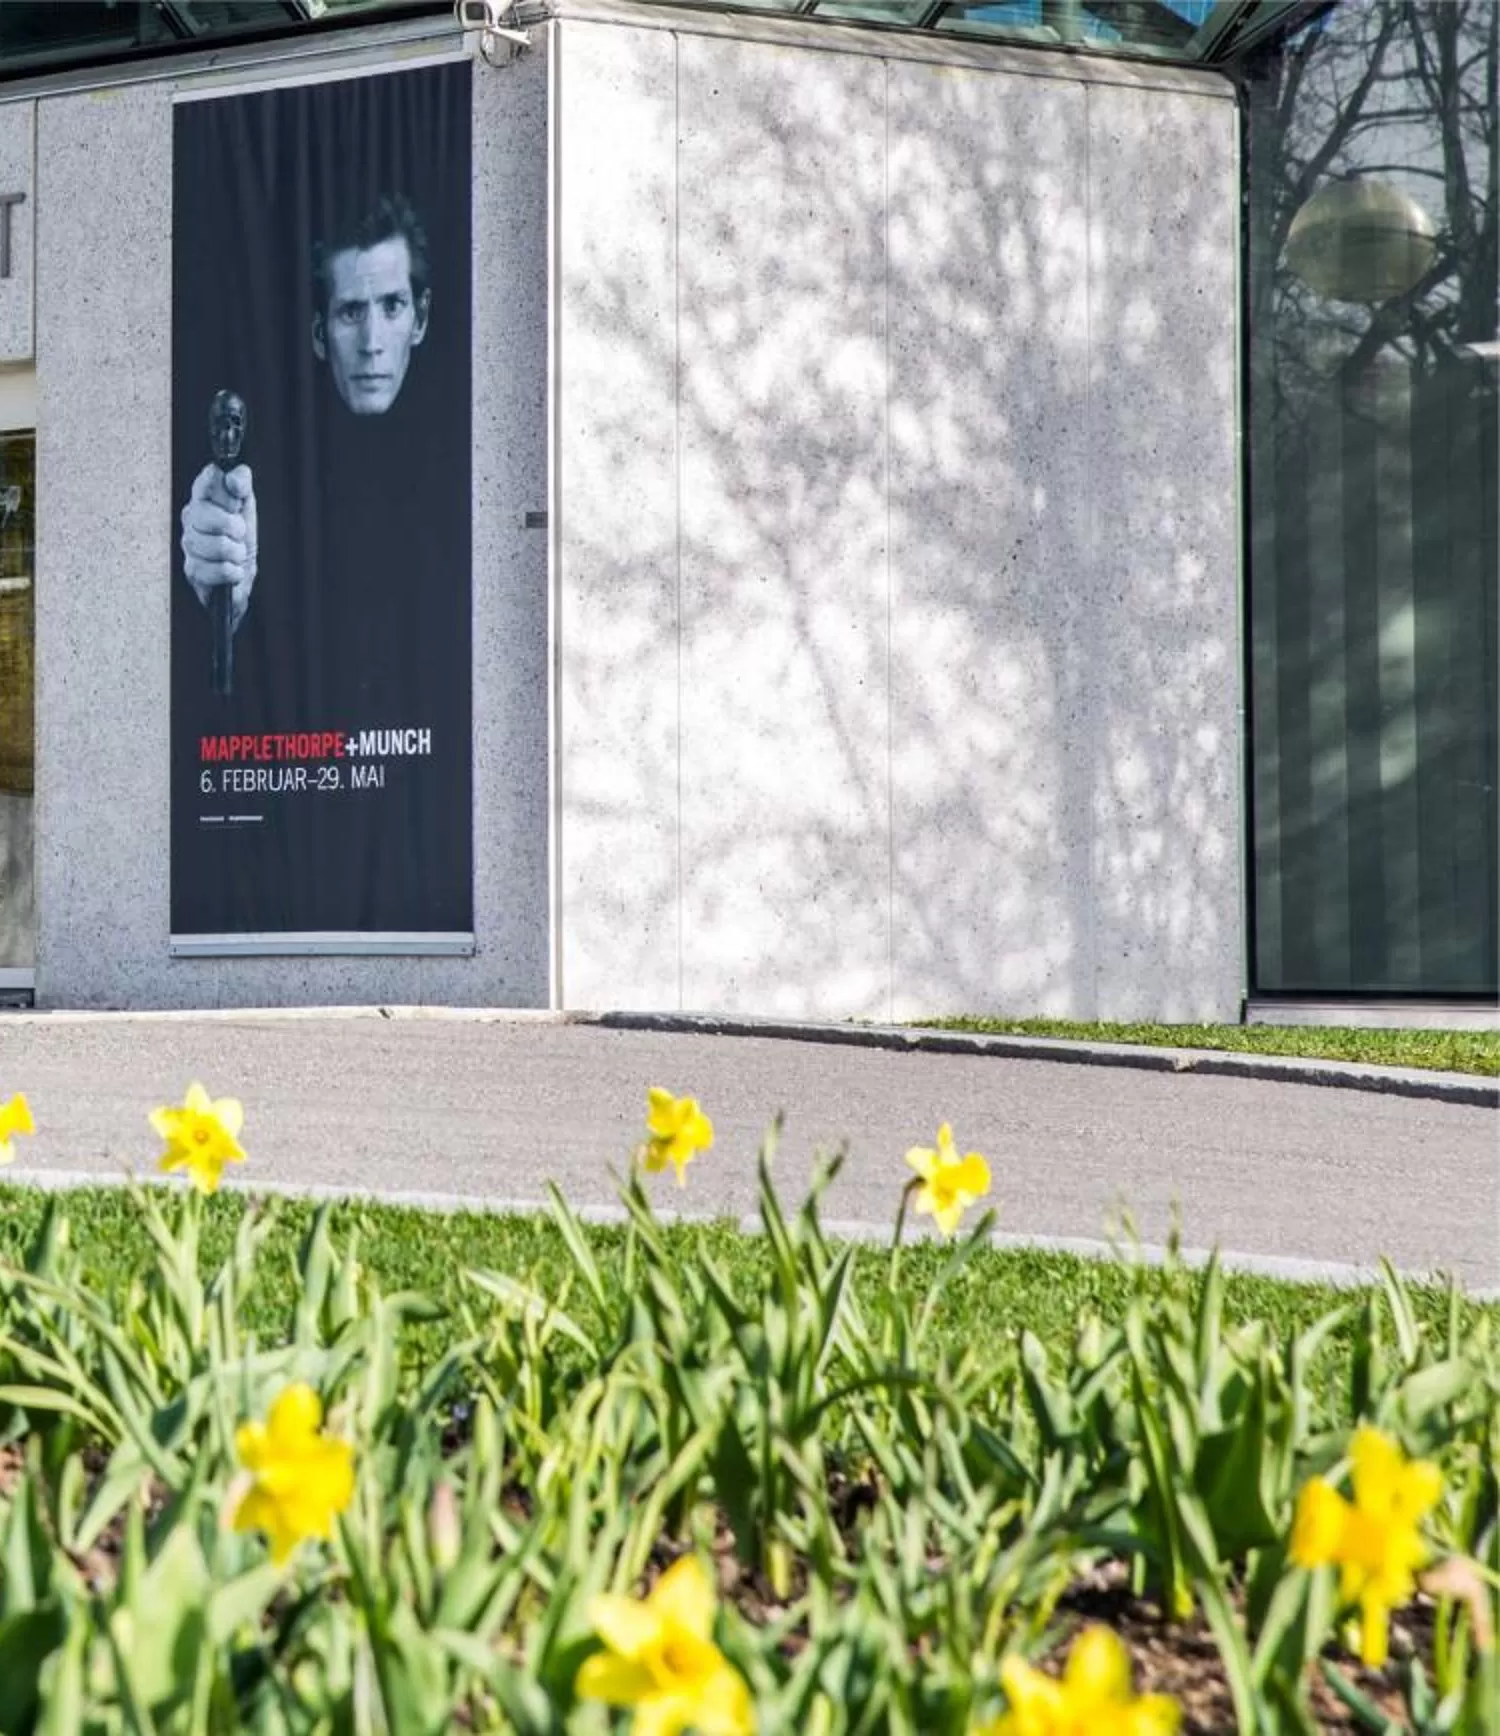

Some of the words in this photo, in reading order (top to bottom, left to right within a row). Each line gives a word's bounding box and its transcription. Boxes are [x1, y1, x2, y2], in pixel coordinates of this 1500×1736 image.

[199, 728, 432, 761] MAPPLETHORPE+MUNCH
[200, 769, 216, 793] 6.
[351, 764, 385, 789] MAI
